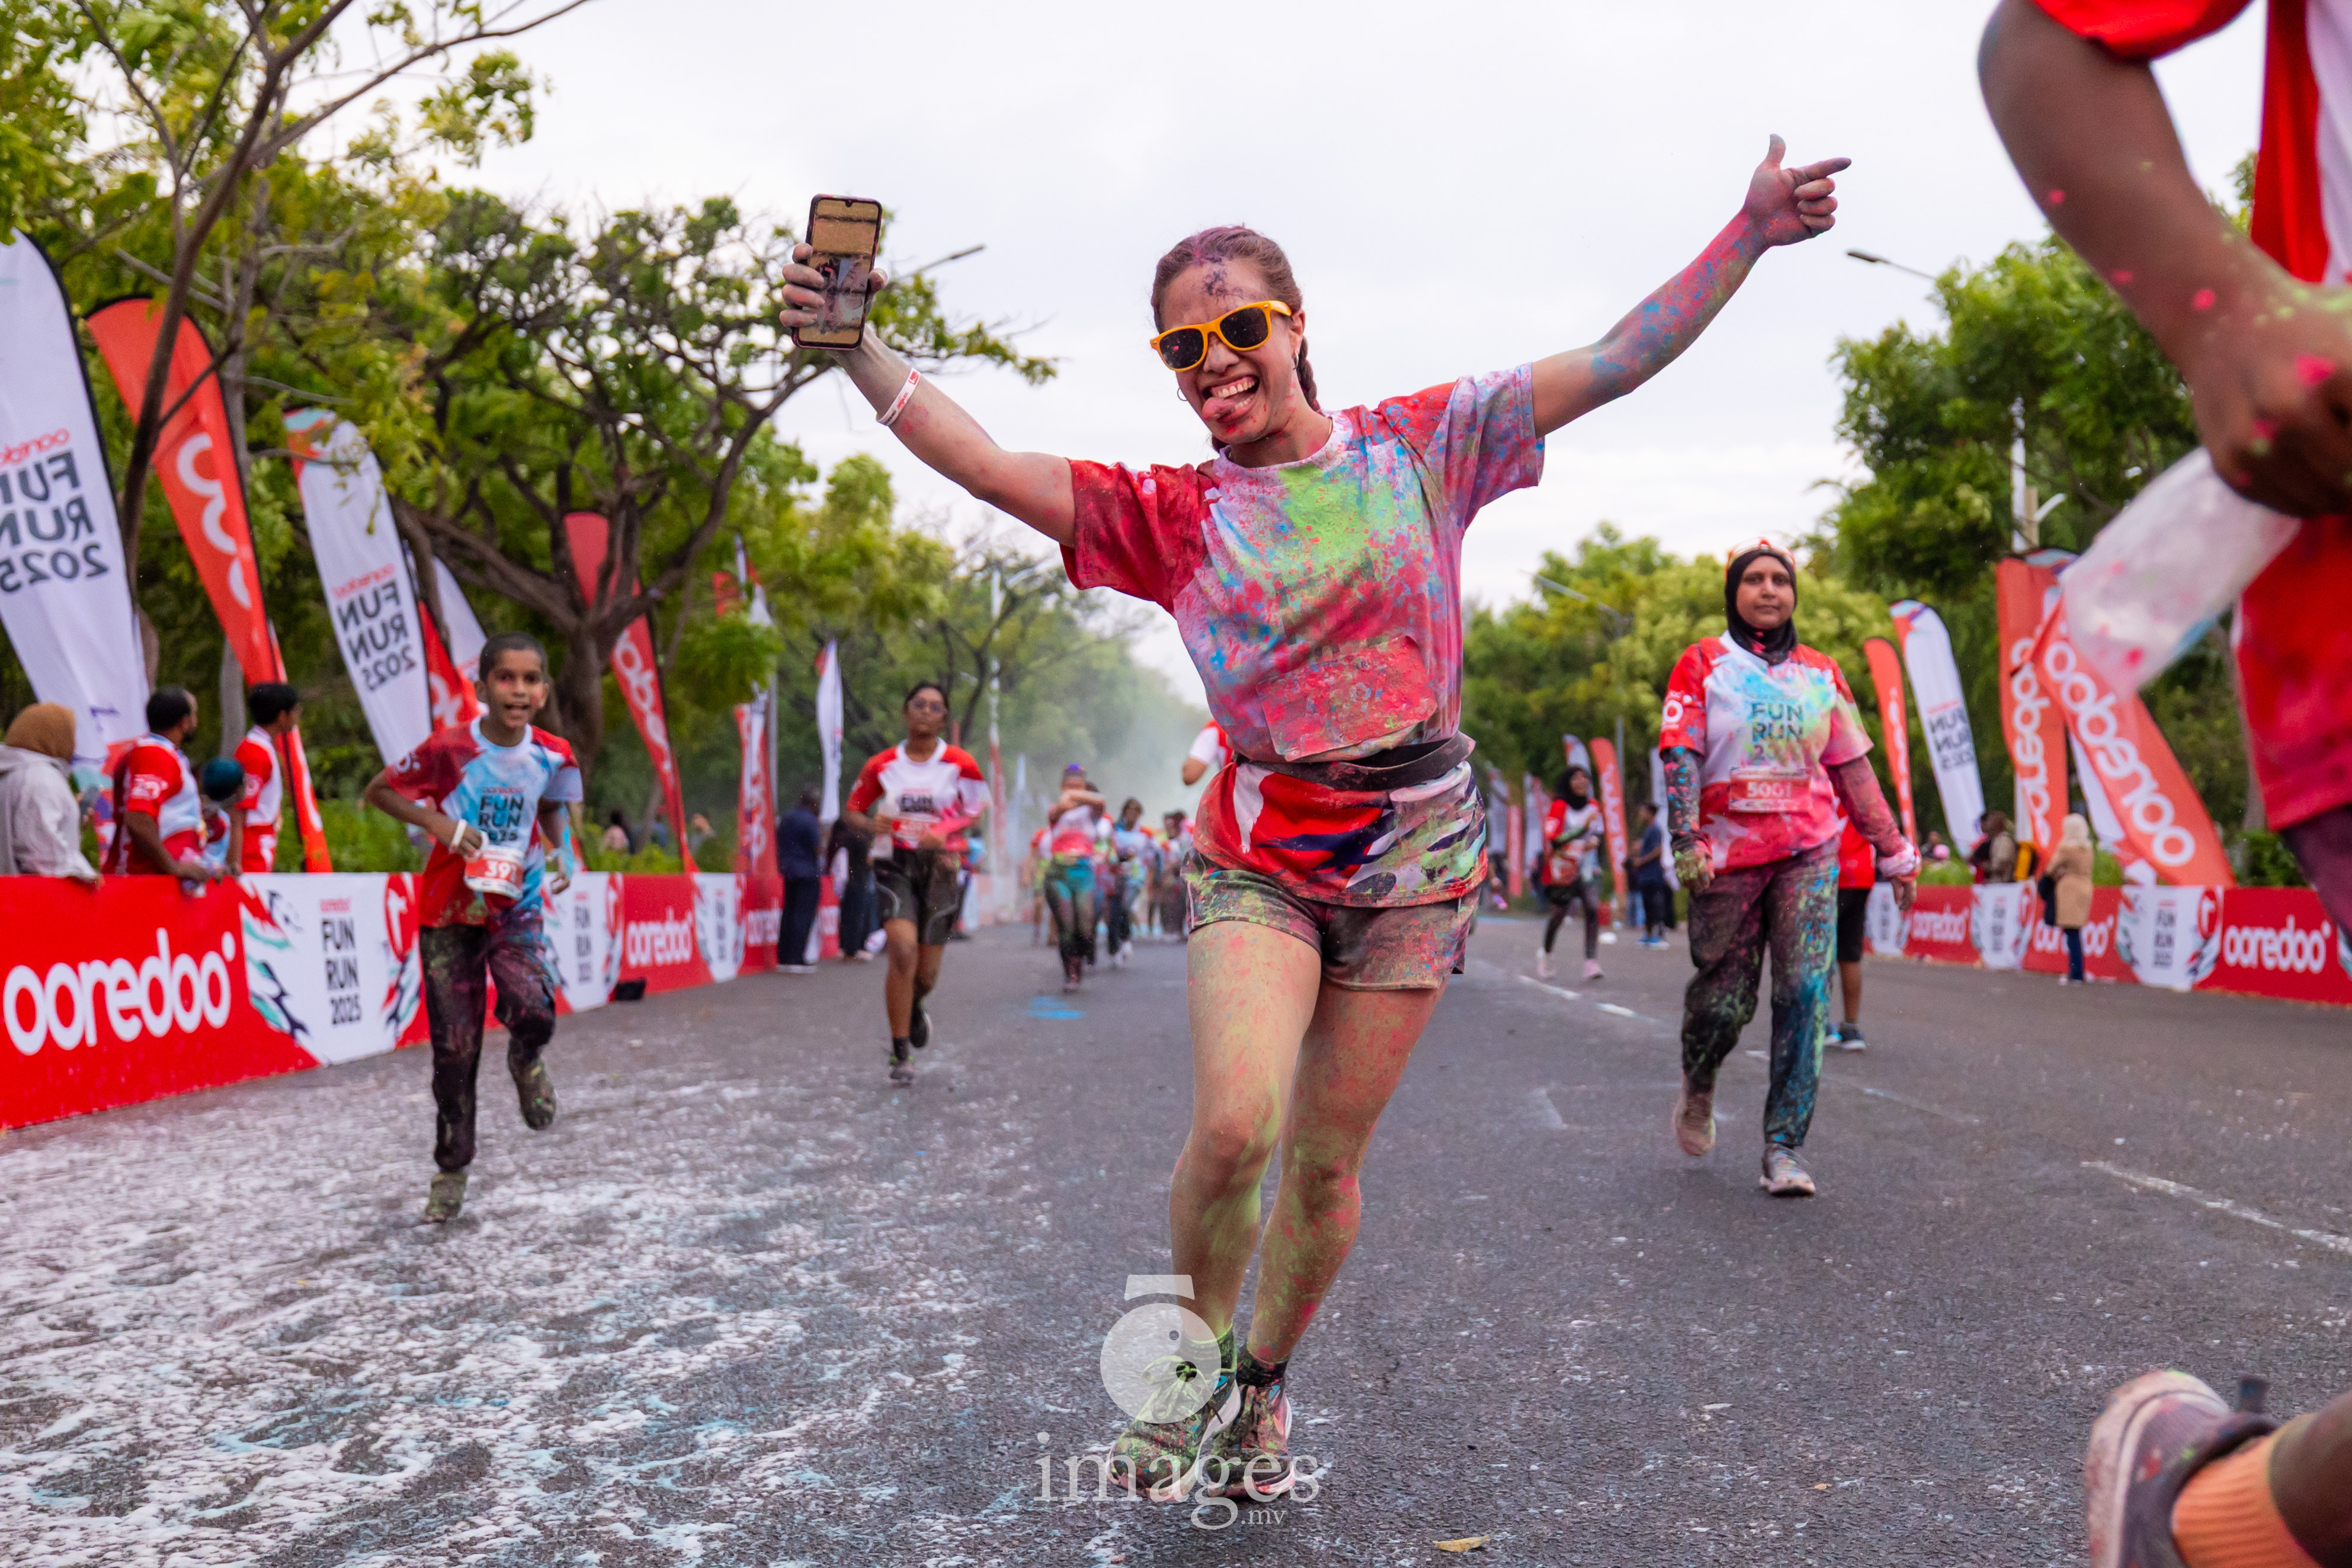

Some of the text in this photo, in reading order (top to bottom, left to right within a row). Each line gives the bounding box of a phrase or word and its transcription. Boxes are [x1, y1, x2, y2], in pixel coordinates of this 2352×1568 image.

[1752, 703, 1803, 722] FUN
[1752, 722, 1803, 743] RUN
[479, 812, 521, 828] RUN
[480, 796, 524, 812] FUN
[323, 918, 355, 951] FUN
[627, 907, 693, 967] ooredoo
[2224, 914, 2331, 974] ooredoo
[325, 955, 359, 990] RUN
[2, 926, 236, 1056] ooredoo
[330, 995, 361, 1027] 2025
